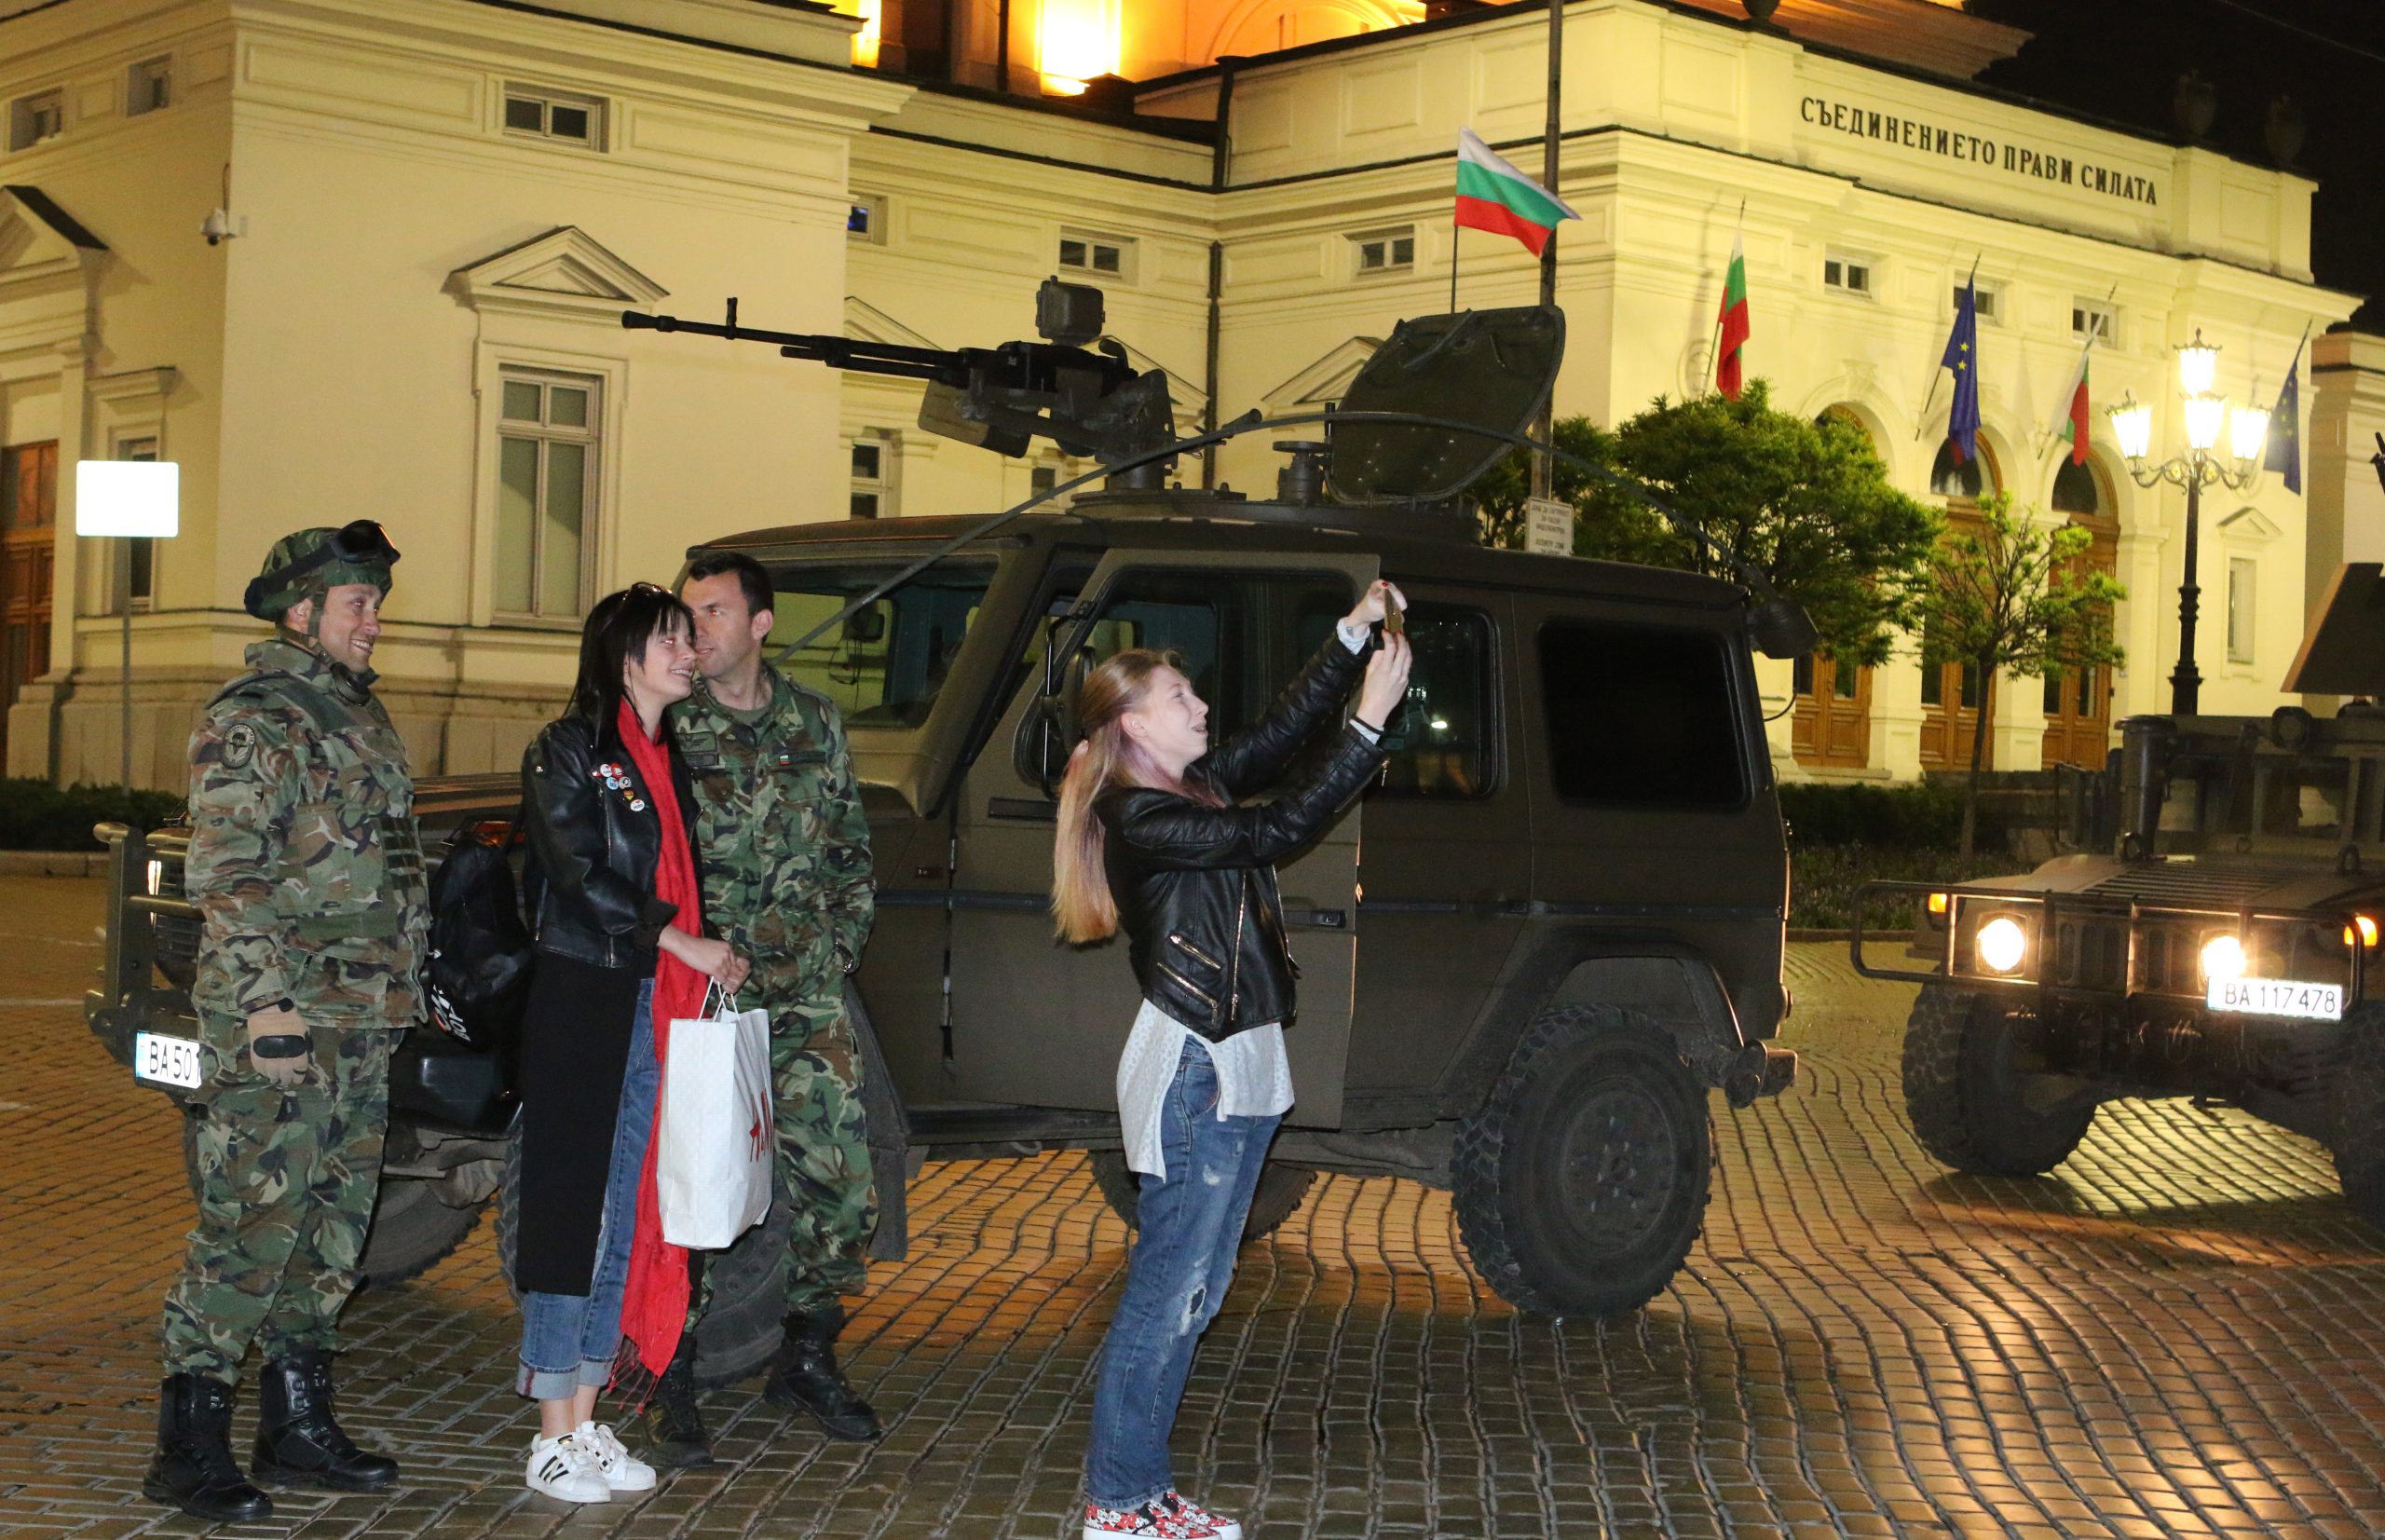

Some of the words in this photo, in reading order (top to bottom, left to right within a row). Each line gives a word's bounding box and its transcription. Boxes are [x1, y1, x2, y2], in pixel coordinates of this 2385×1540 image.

[1801, 96, 1996, 165] СЪЕДИНЕНИЕТО
[2003, 145, 2073, 185] ПРАВИ
[2080, 164, 2158, 206] СИЛАТА
